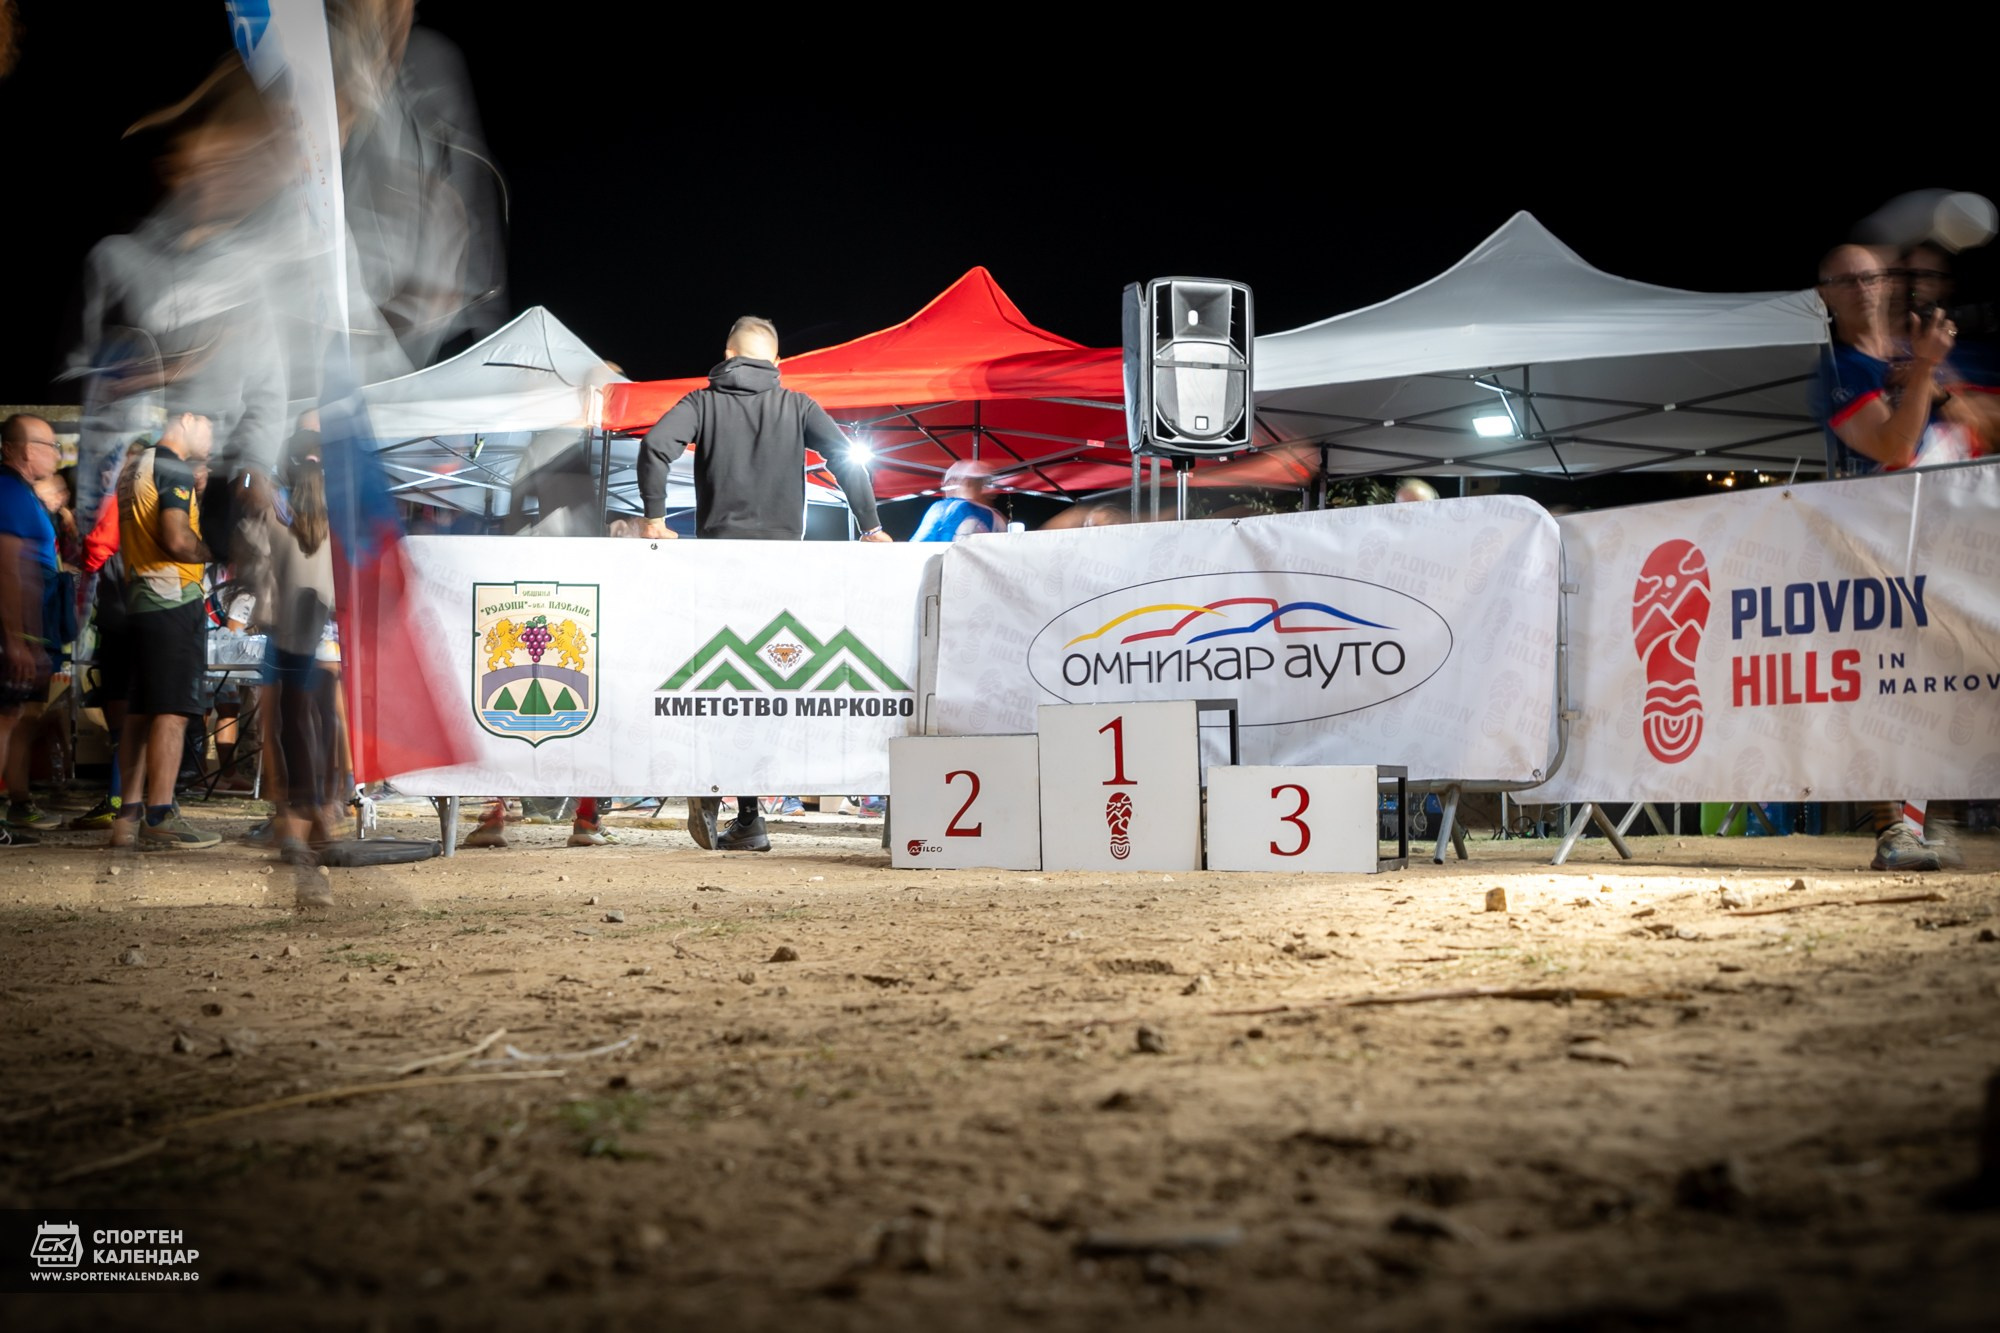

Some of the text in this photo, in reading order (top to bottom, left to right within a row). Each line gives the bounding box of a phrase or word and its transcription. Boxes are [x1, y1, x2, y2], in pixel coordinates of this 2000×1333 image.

[1732, 649, 1862, 708] HILLS
[1878, 652, 1905, 670] IN
[655, 697, 914, 717] КМЕТСТВО МАРКОВО
[1099, 716, 1138, 786] 1
[945, 770, 982, 838] 2
[1269, 784, 1311, 857] 3
